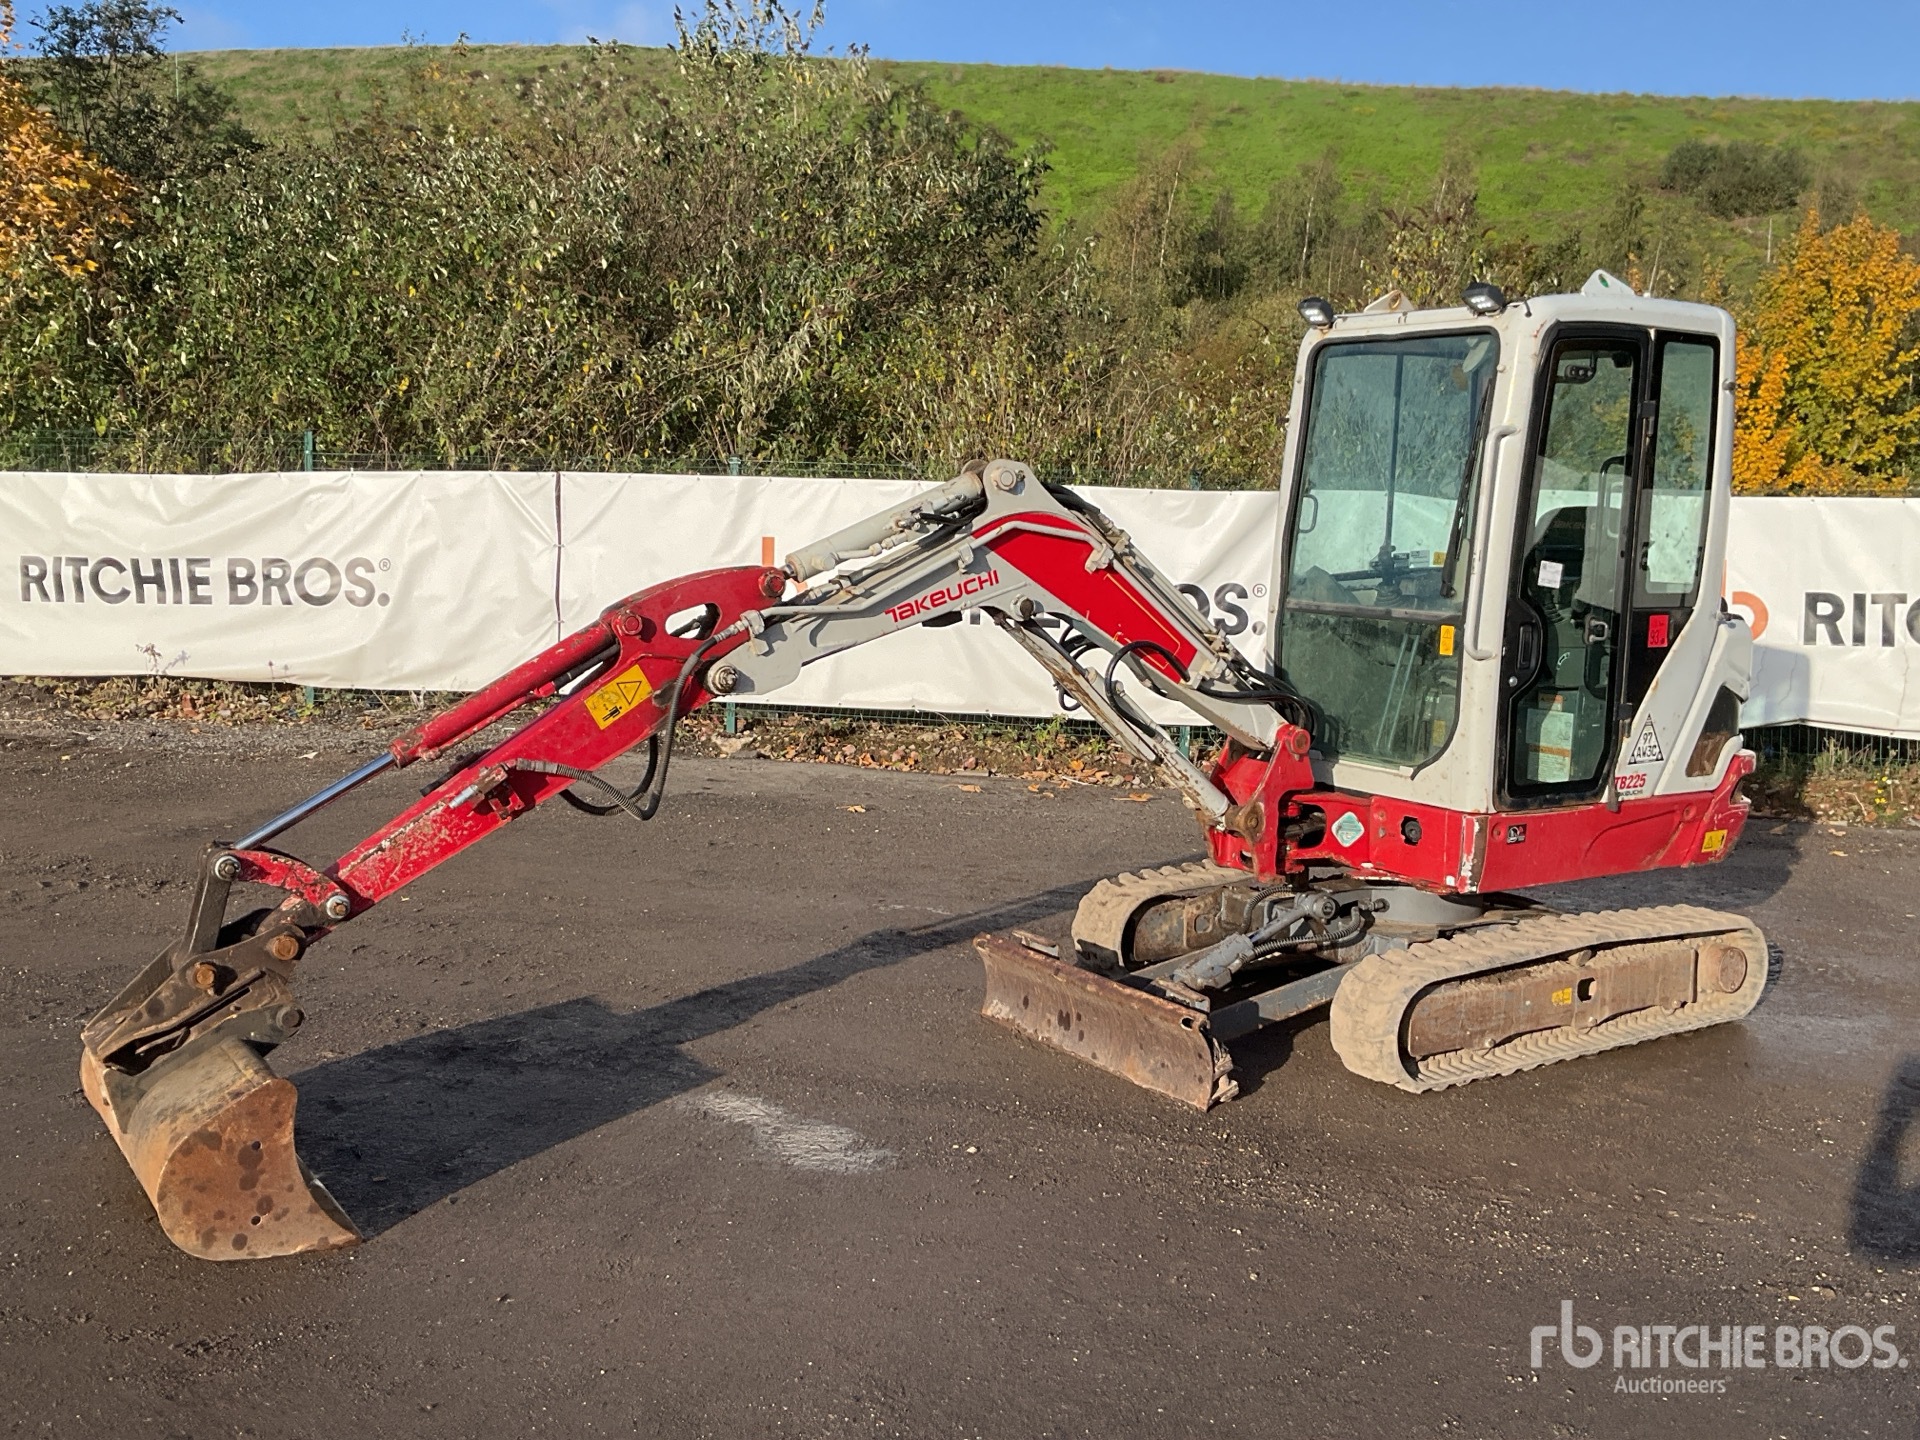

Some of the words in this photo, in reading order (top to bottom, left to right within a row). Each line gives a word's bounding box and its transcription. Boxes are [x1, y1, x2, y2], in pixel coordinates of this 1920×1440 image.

[19, 555, 213, 605] RITCHIE
[884, 570, 999, 623] TAKEUCHI
[1803, 591, 1920, 648] RIT
